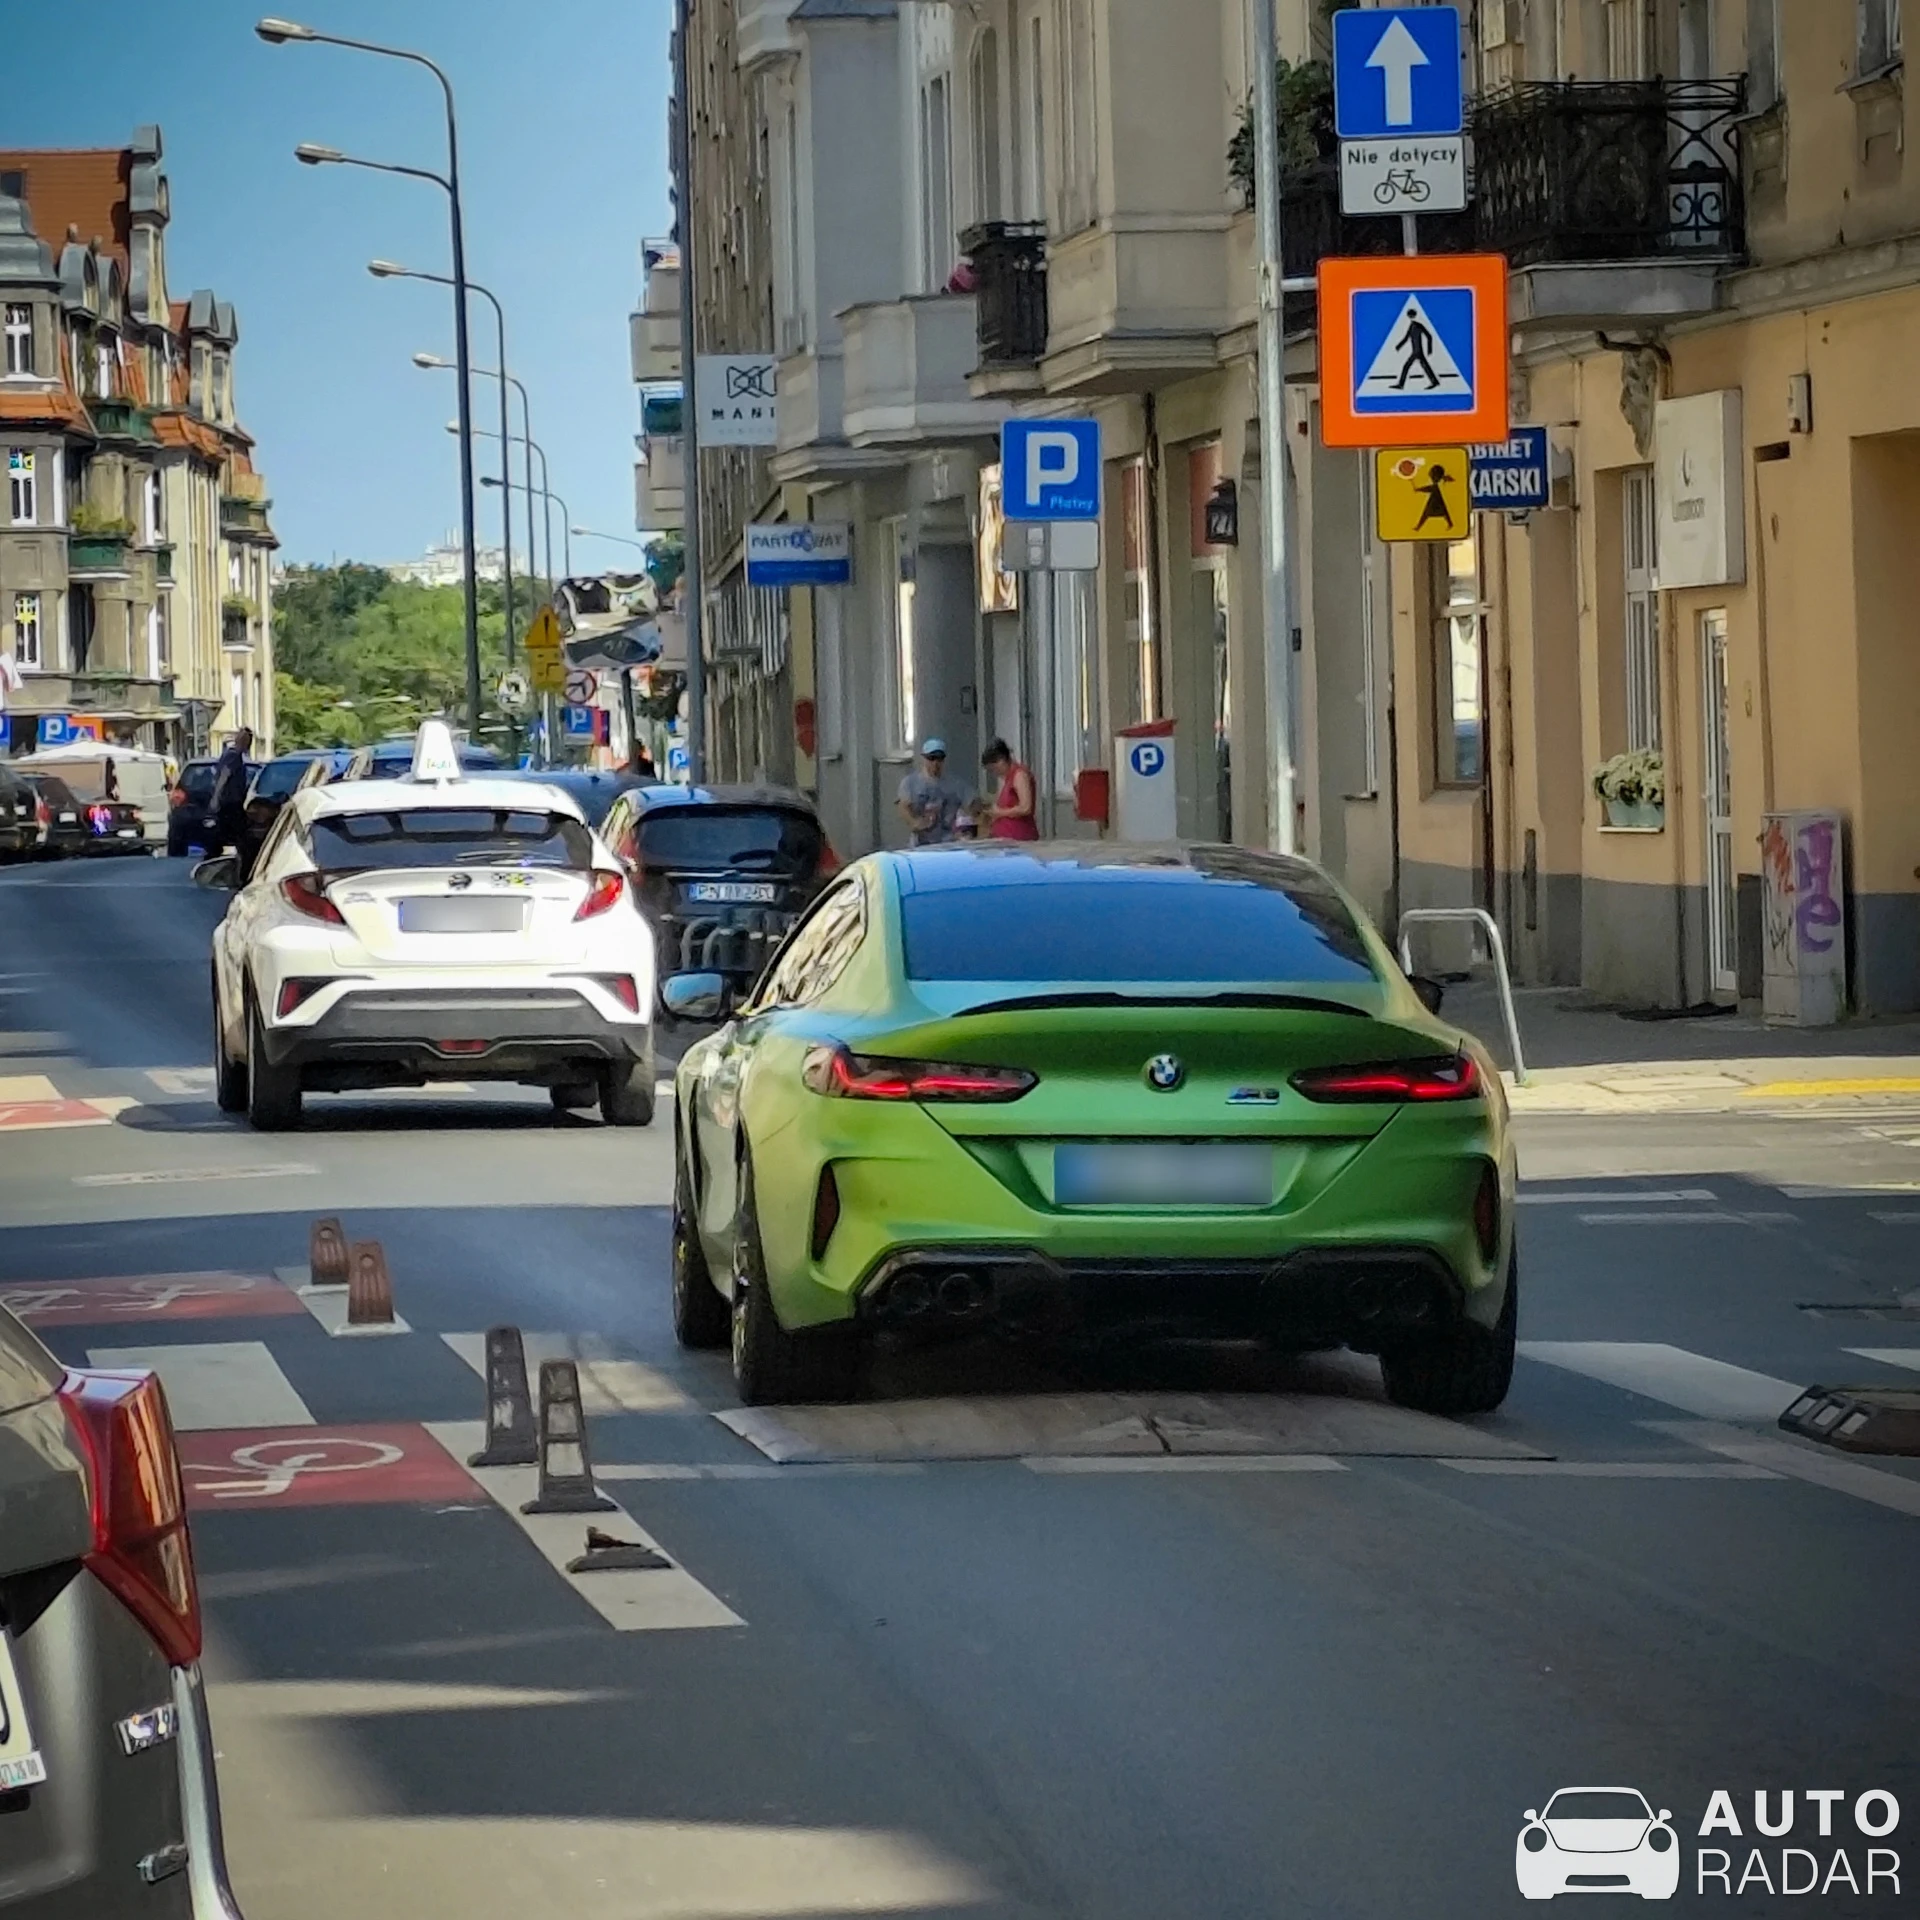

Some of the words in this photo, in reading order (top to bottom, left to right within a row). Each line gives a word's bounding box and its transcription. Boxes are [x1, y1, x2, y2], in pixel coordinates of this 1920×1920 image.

[1347, 149, 1378, 164] Nie
[1389, 147, 1457, 165] dotyczy
[1026, 431, 1079, 506] P
[45, 718, 63, 740] P
[1139, 747, 1158, 773] P
